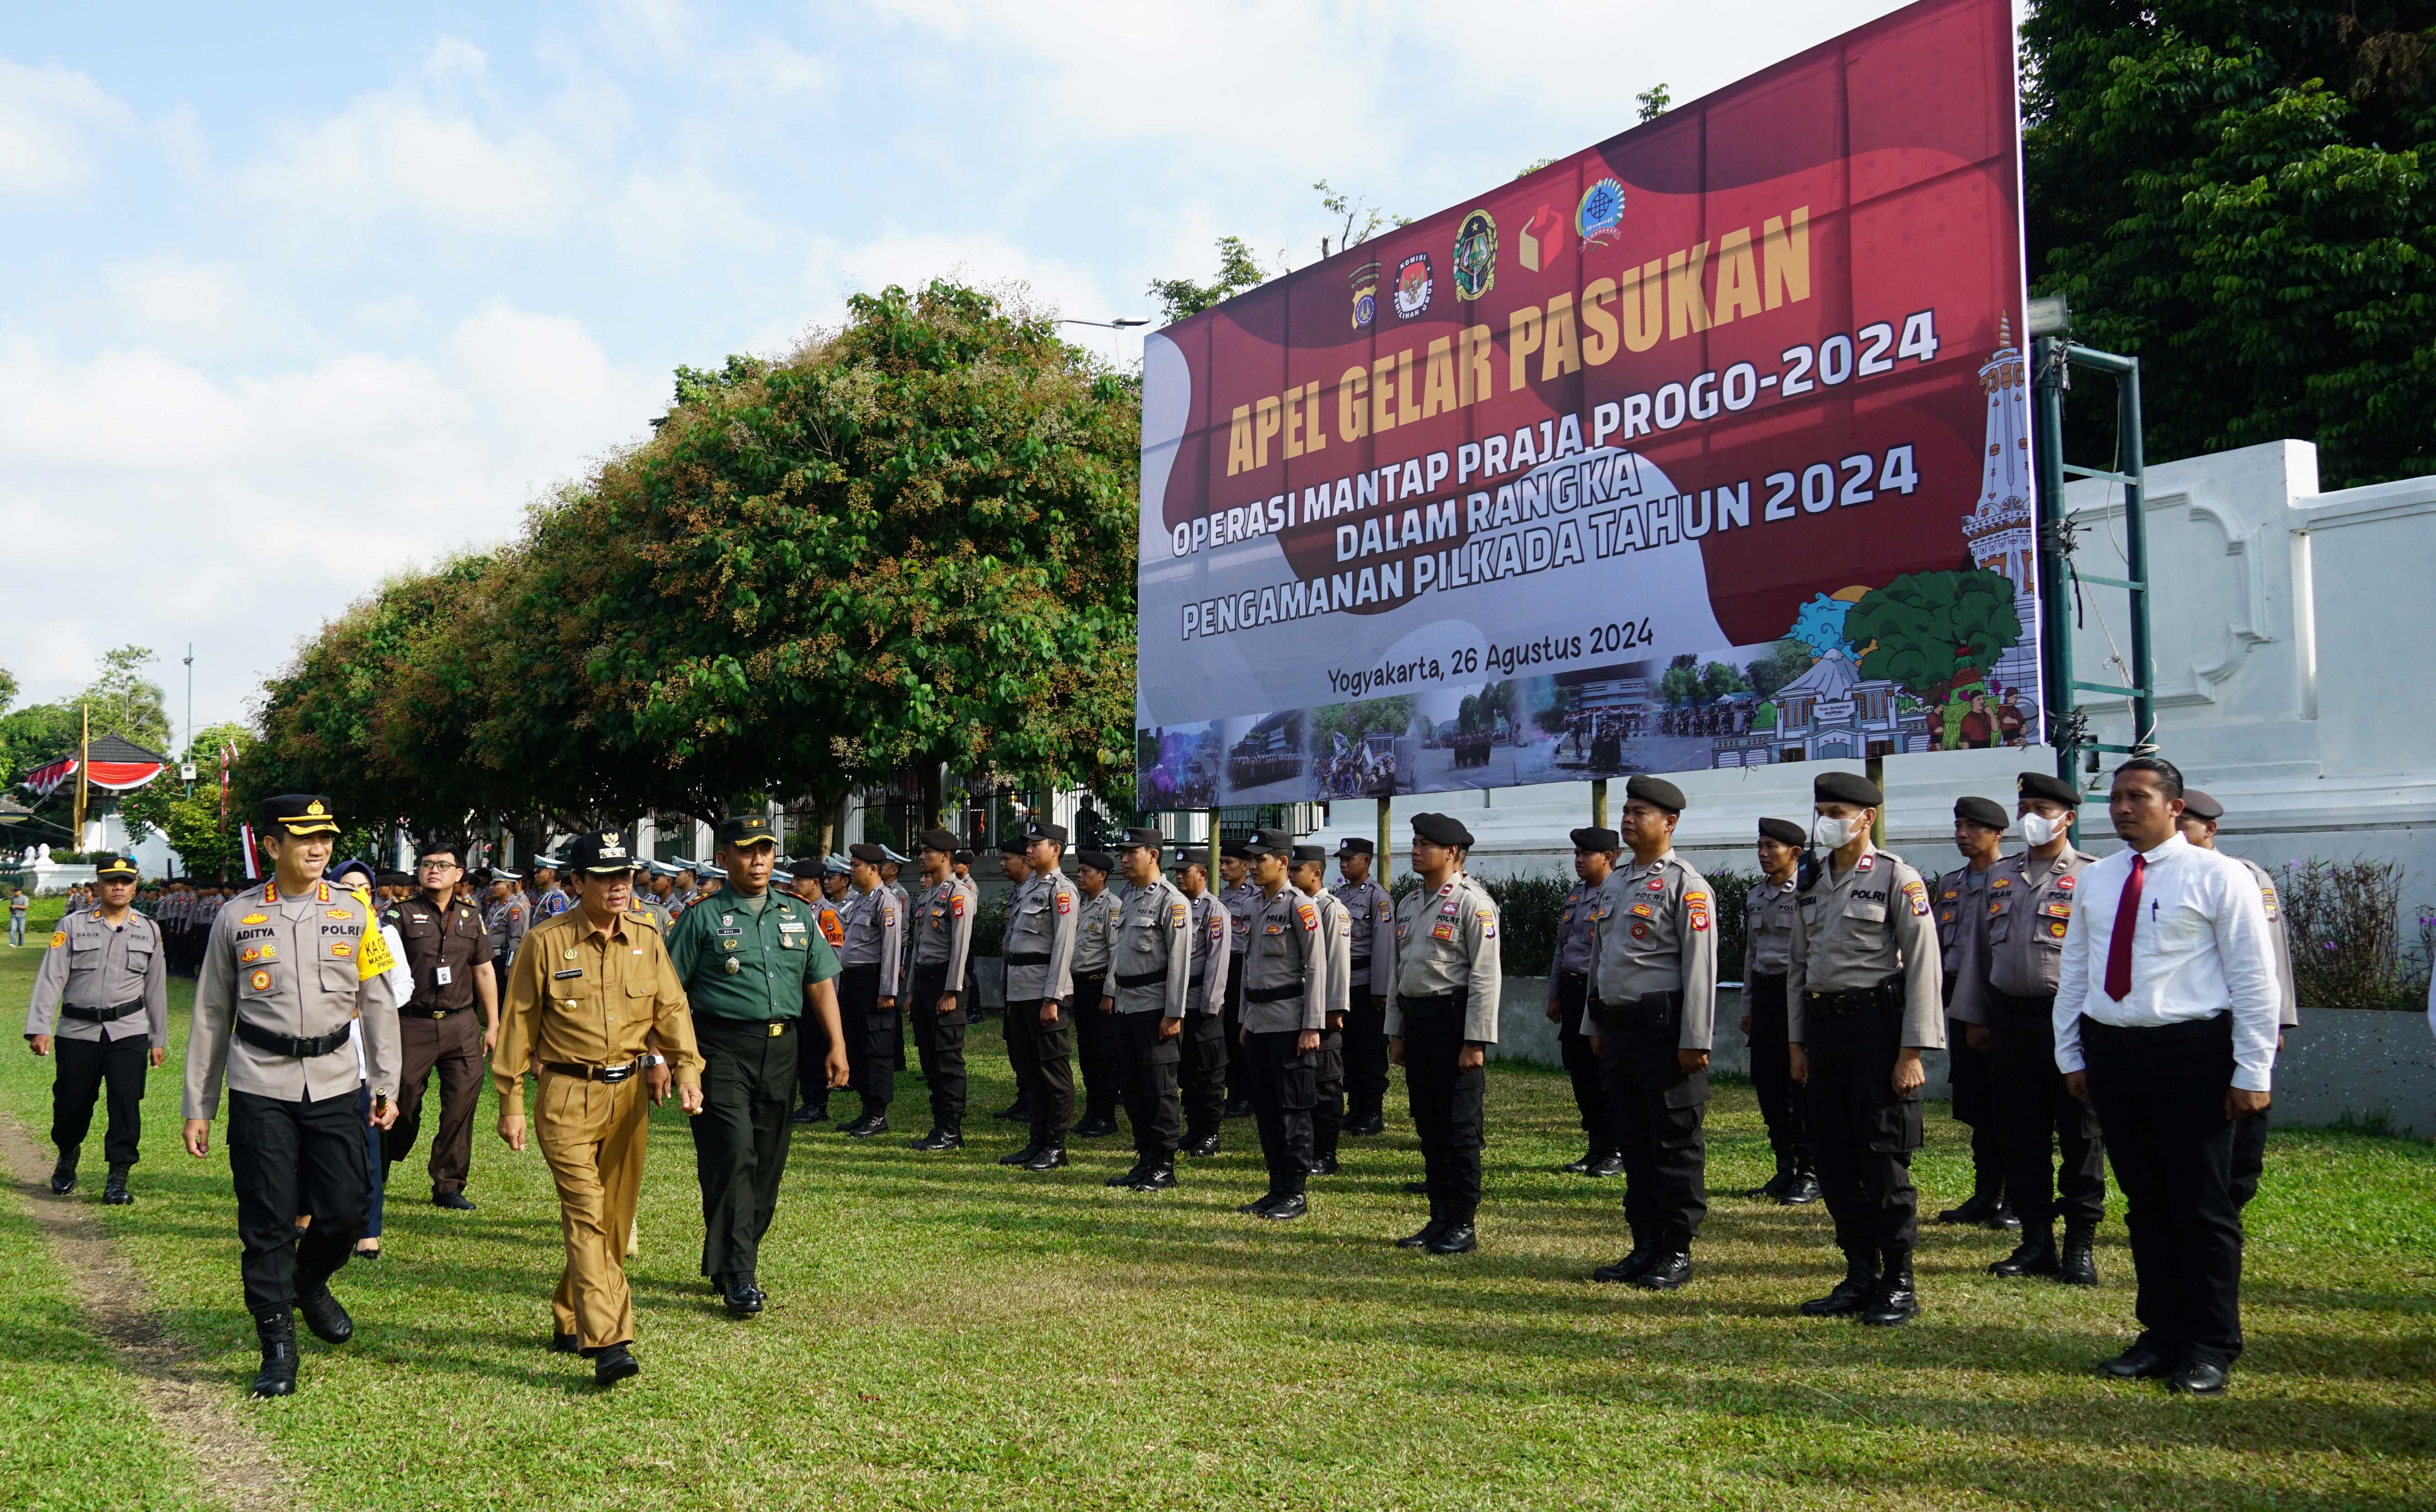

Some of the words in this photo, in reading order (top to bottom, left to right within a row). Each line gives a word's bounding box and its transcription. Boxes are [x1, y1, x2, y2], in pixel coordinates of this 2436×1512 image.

[1400, 254, 1427, 269] KOMISI
[1393, 292, 1419, 320] PEMILIHAN
[1422, 279, 1433, 311] UMUM
[1227, 379, 1326, 477] APEL
[1339, 323, 1492, 444] GELAR
[1509, 205, 1811, 392] PASUKAN
[1172, 494, 1296, 557] OPERASI
[1302, 451, 1449, 525] MANTAP
[1457, 413, 1585, 485] PRAJA
[1593, 308, 1940, 451] PROGO-2024
[1336, 499, 1458, 564] DALAM
[1466, 451, 1642, 533] RANGKA
[1182, 560, 1404, 641] PENGAMANAN
[1413, 518, 1585, 595] PILKADA
[1590, 480, 1751, 561] TAHUN
[1763, 442, 1919, 524] 2024
[1328, 656, 1445, 697] Yogyakarta,
[1451, 648, 1477, 674] 26
[1485, 635, 1582, 675] Agustus
[1590, 617, 1654, 655] 2024
[1030, 897, 1045, 905] POLRI
[1635, 892, 1664, 902] POLRI
[1851, 890, 1886, 902] POLRI
[1266, 915, 1287, 923] POLRI
[1436, 915, 1459, 924] POLRI
[236, 927, 275, 942] ADITYA
[322, 925, 359, 936] POLRI
[365, 941, 379, 957] KA
